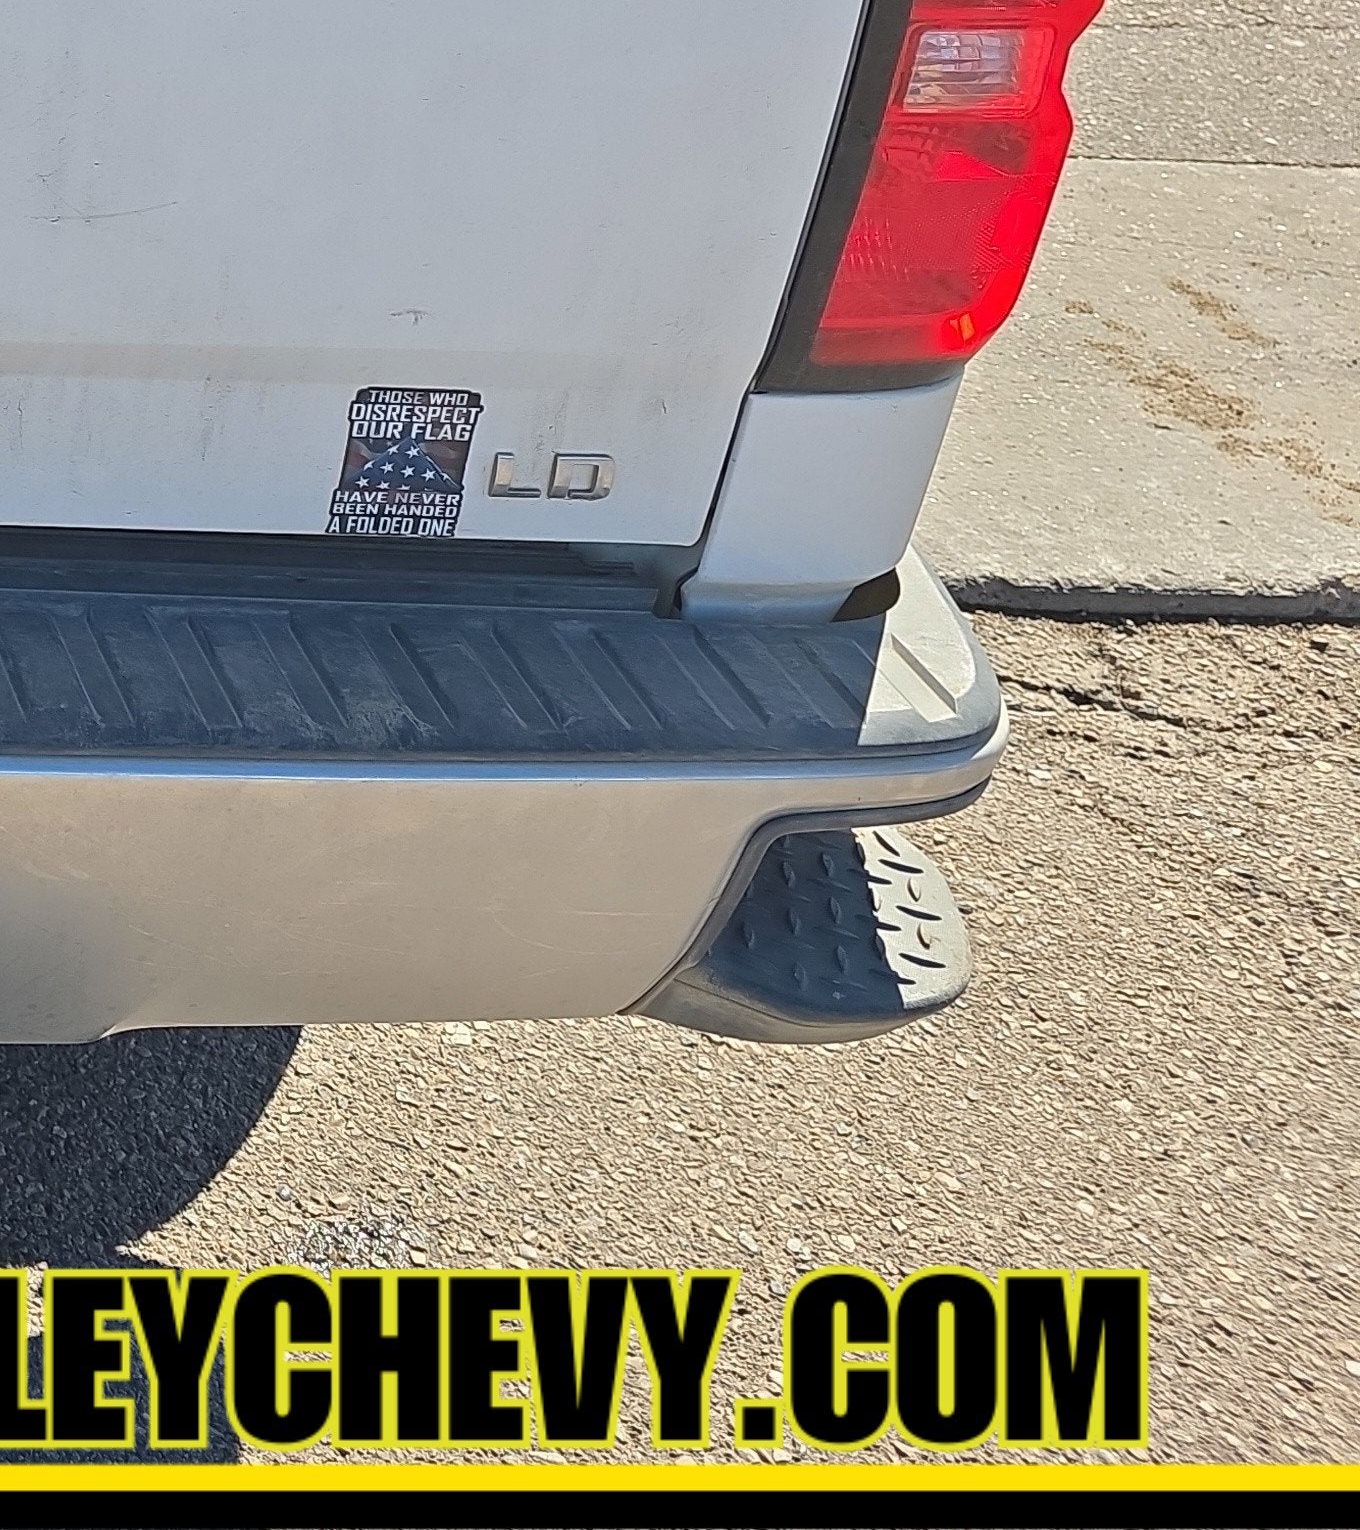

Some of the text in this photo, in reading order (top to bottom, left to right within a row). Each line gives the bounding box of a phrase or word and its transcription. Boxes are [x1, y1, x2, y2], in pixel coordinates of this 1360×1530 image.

[368, 389, 469, 407] THOSE WHO
[350, 403, 481, 425] DISRESPECT
[351, 420, 473, 442] OUR FLAG
[488, 451, 615, 501] LD
[334, 490, 461, 507] HAVE NEVER
[332, 502, 459, 519] BEEN HANDED
[328, 516, 456, 538] A FOLDED ONE
